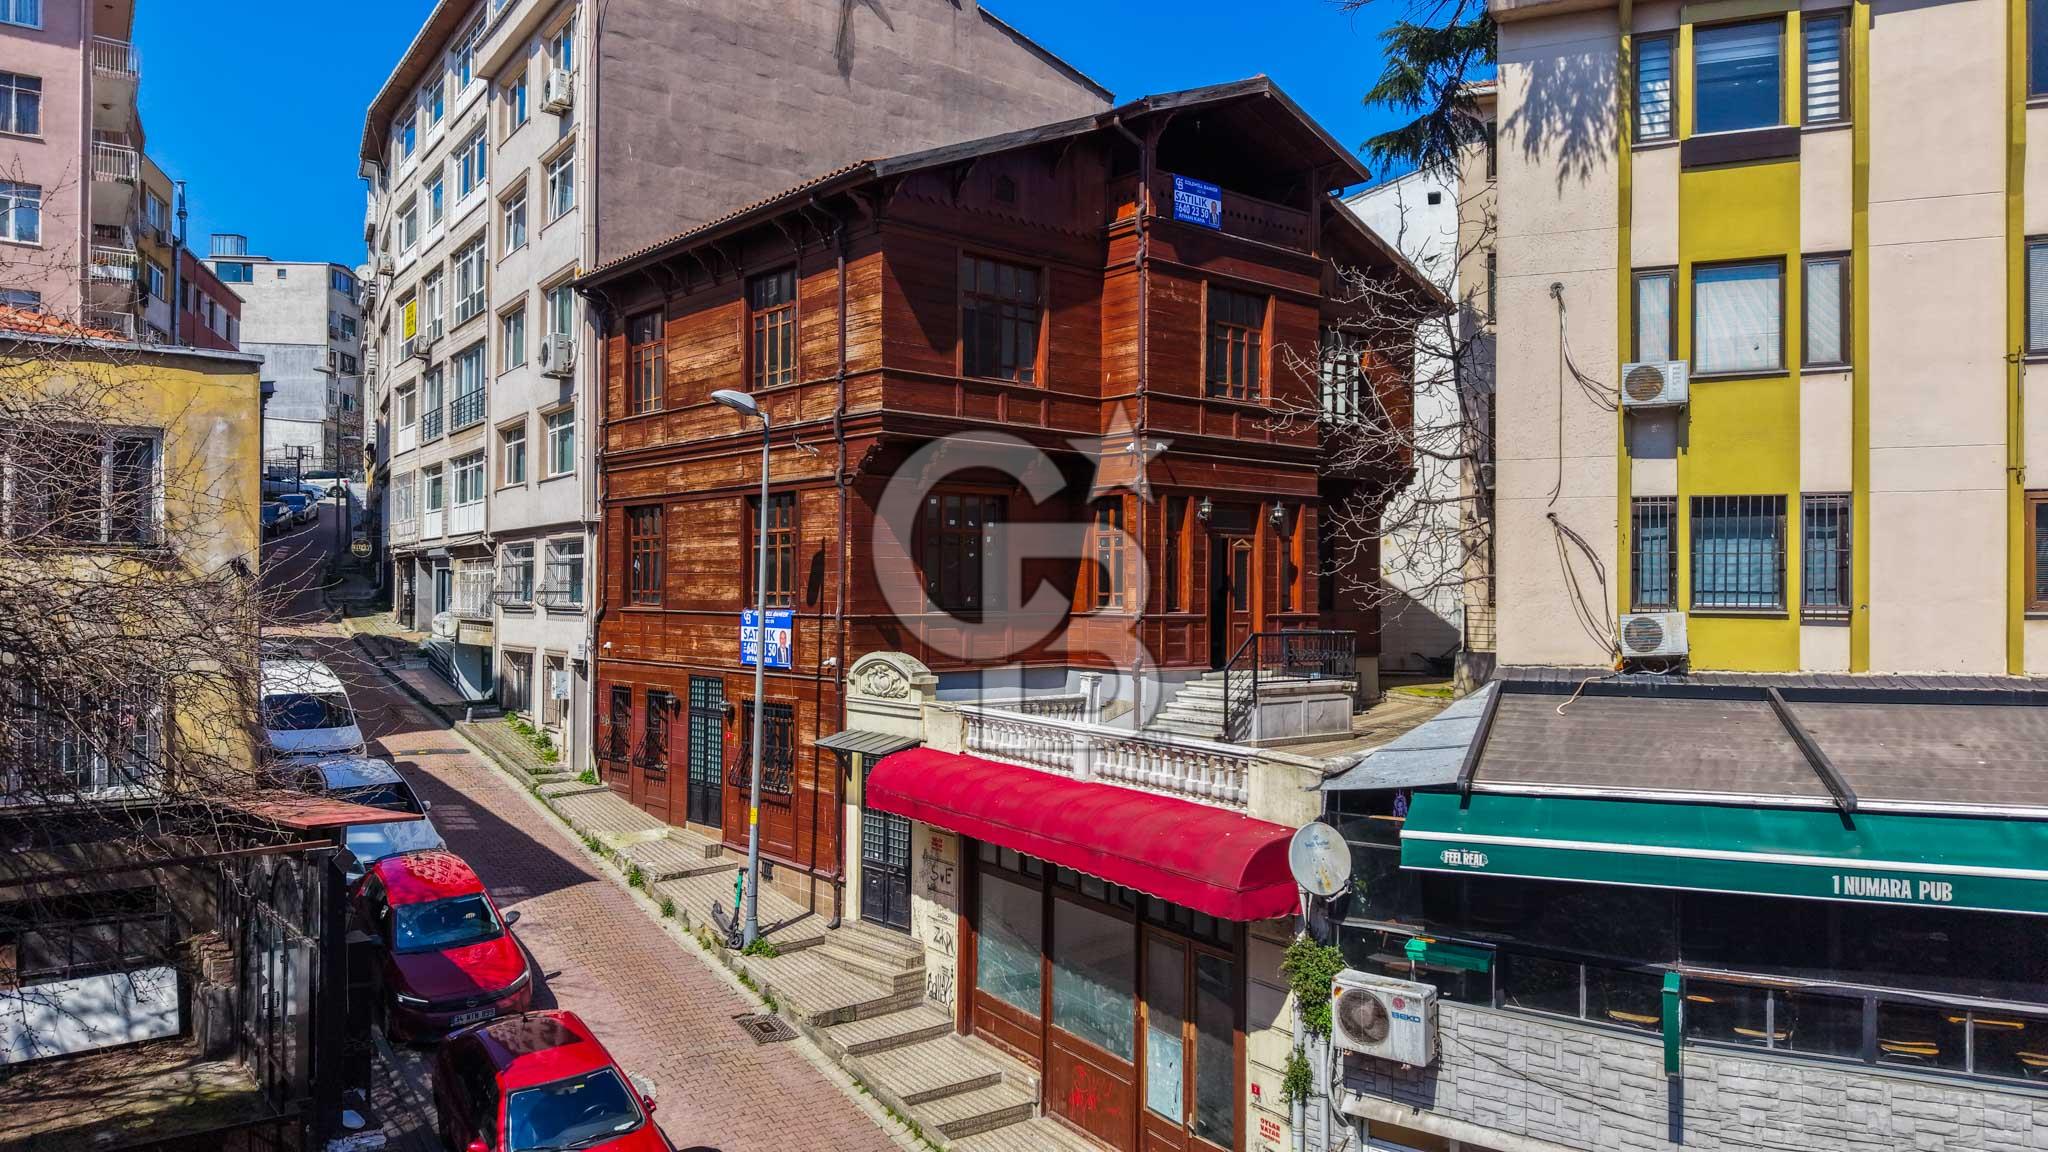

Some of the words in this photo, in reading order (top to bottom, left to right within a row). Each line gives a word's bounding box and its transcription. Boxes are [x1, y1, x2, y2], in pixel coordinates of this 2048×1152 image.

[1175, 191, 1208, 208] SATILIK
[1178, 202, 1191, 214] 640
[1191, 206, 1200, 216] 23
[1200, 208, 1209, 219] 50
[743, 628, 776, 642] SATIK
[746, 641, 758, 655] 640
[768, 643, 777, 657] 50
[1443, 851, 1462, 865] FEEL
[1462, 852, 1485, 867] REAL
[1832, 875, 1840, 895] 1
[1844, 875, 1912, 900] NUMARA
[1919, 880, 1953, 902] PUB
[1391, 1011, 1421, 1023] BEKO
